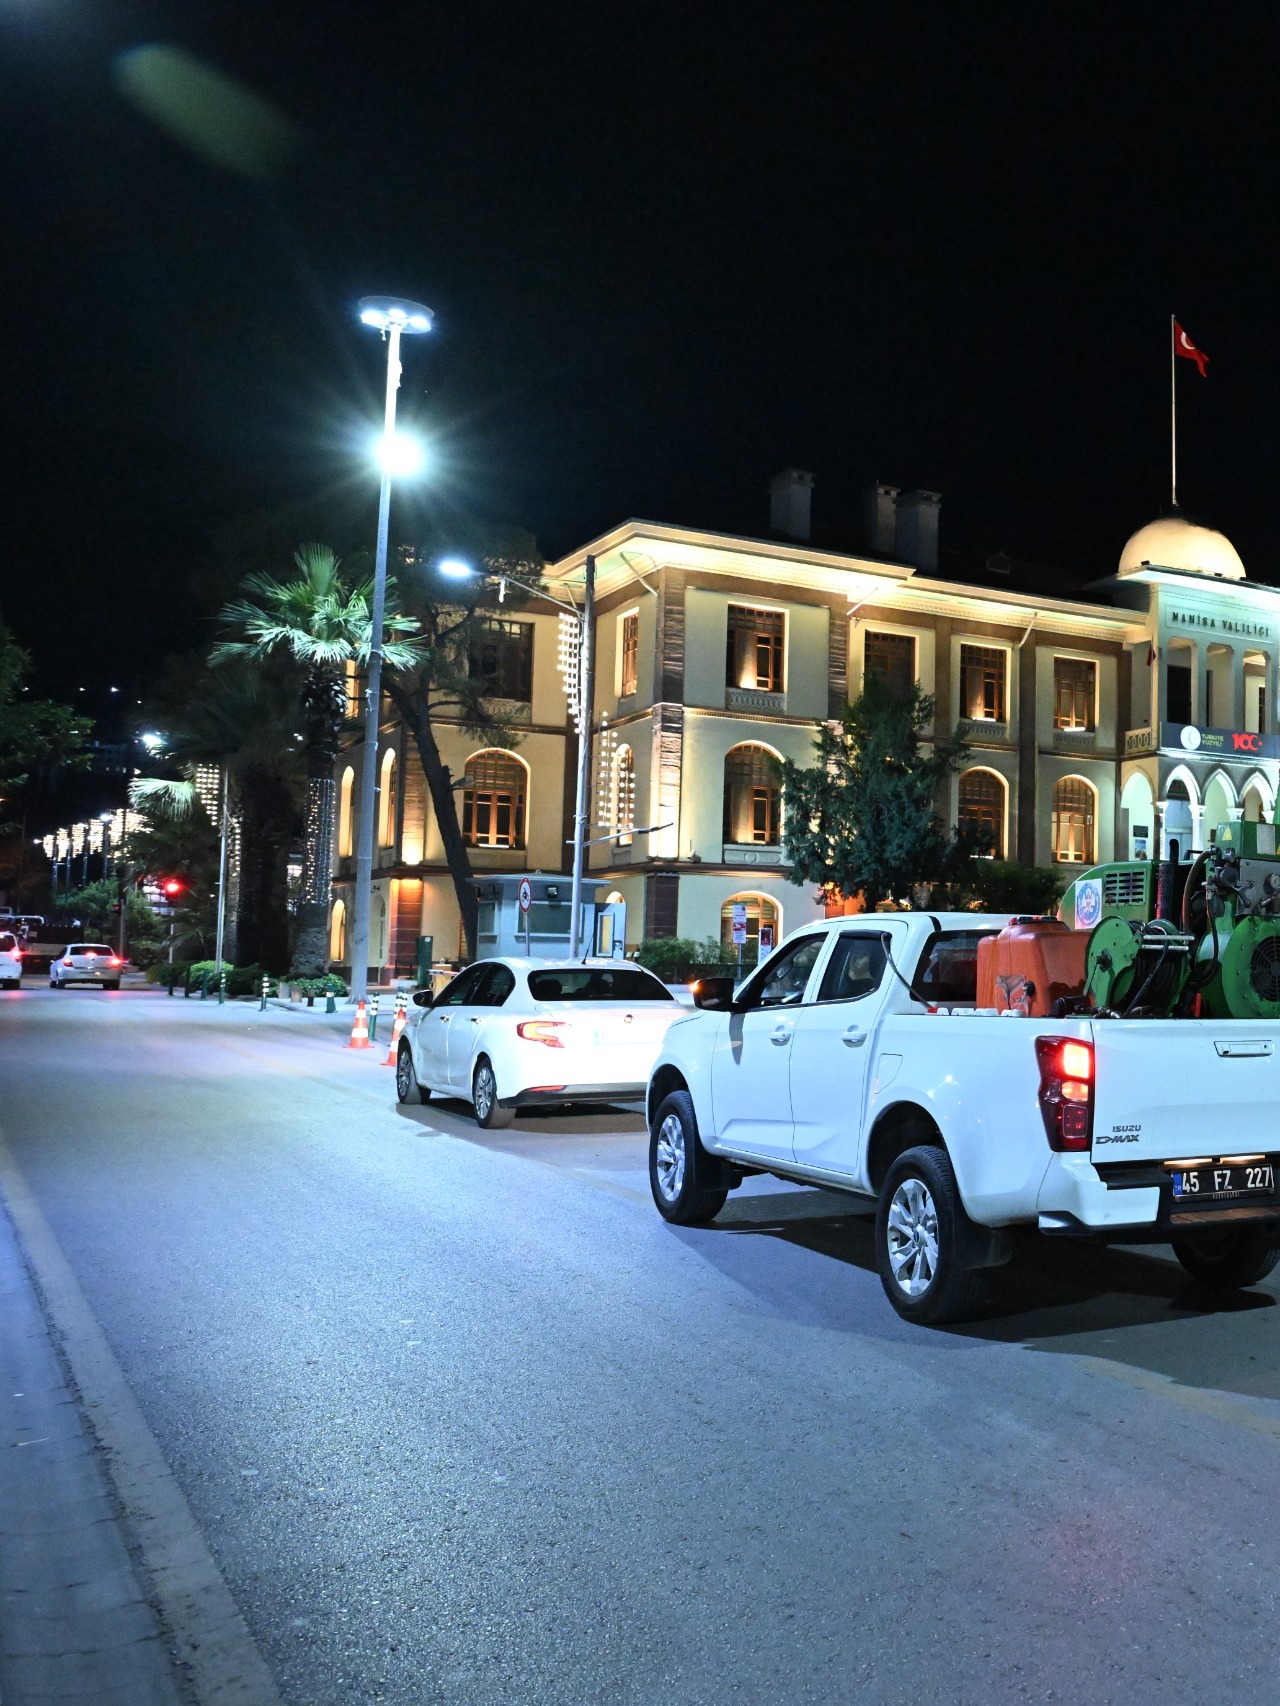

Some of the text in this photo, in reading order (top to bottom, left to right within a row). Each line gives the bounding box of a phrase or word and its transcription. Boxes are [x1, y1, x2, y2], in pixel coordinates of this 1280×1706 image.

[1172, 611, 1216, 628] MANİSA
[1112, 1124, 1141, 1133] ISUZU
[1182, 1171, 1200, 1193] 45
[1213, 1170, 1233, 1191] FZ
[1245, 1166, 1271, 1188] 227
